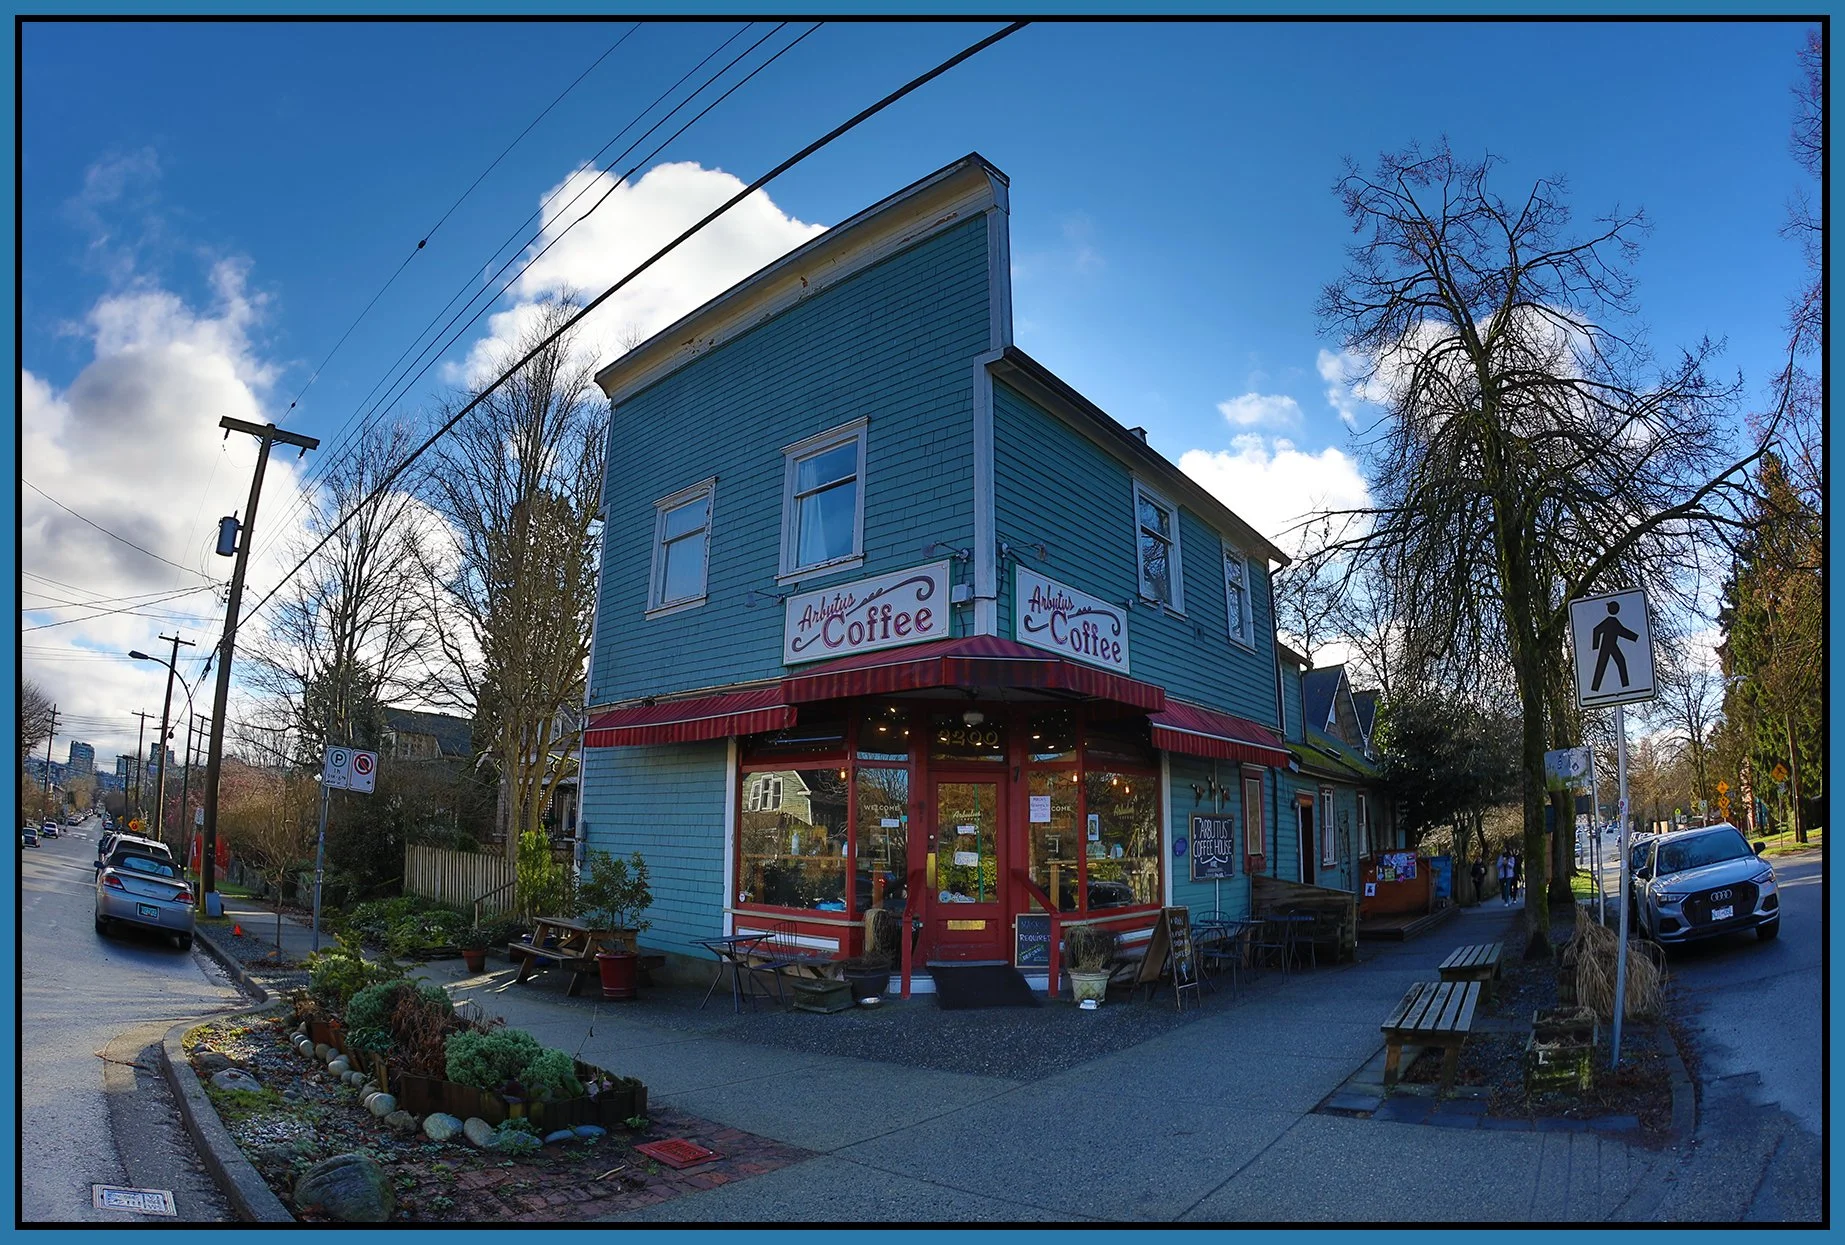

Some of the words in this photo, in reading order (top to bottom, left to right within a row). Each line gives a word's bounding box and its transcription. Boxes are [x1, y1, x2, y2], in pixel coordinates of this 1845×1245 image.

[798, 593, 856, 632] Arbutus
[1028, 585, 1075, 613] Arbutus
[821, 603, 934, 649] Coffee
[1050, 610, 1122, 663] Coffee
[1200, 819, 1228, 839] ARBUTUS
[1193, 839, 1214, 857] COFFEE
[1214, 839, 1232, 855] HOUSE
